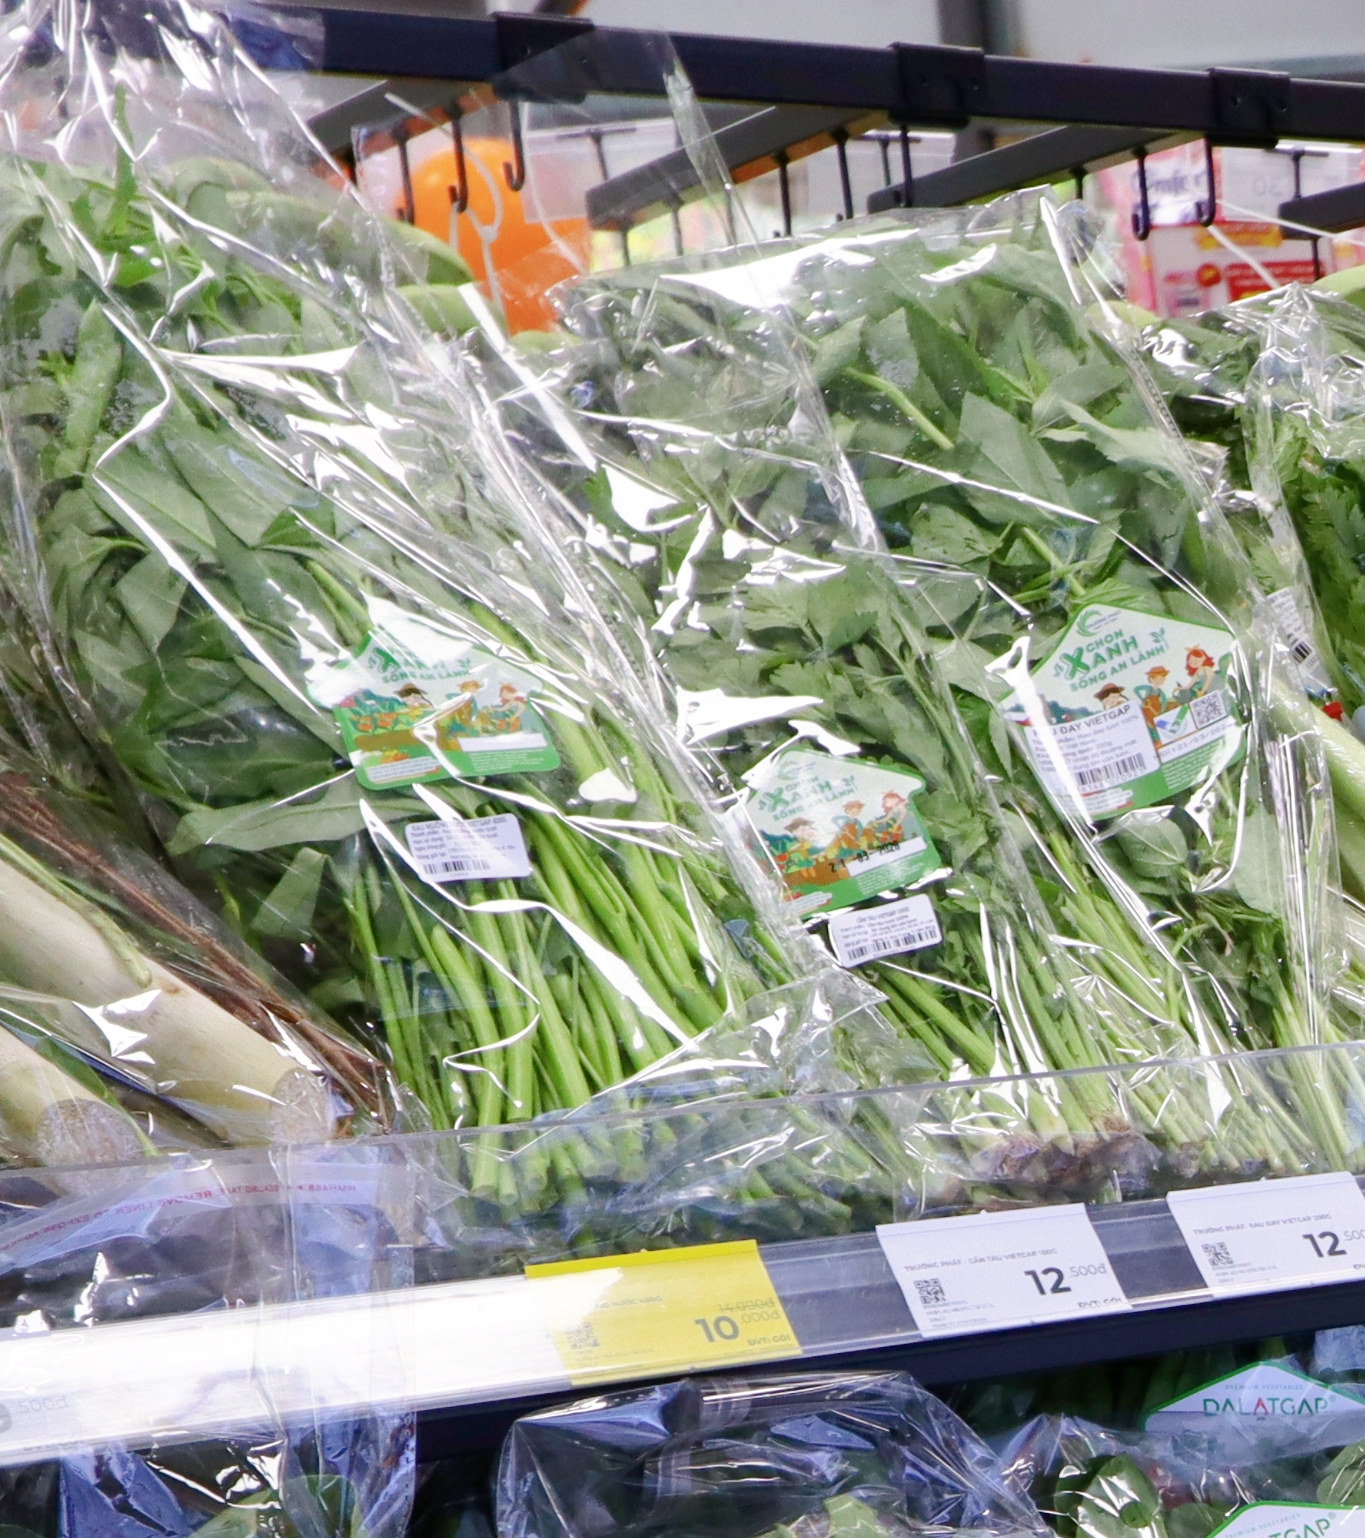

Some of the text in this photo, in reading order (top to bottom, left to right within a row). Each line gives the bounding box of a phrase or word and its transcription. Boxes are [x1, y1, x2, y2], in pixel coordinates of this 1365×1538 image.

[1060, 635, 1139, 681] XANH
[1110, 660, 1128, 677] AN
[1085, 704, 1131, 729] VIETGAP
[1302, 1230, 1347, 1259] 12
[1023, 1266, 1073, 1297] 12
[694, 1315, 740, 1343] 10
